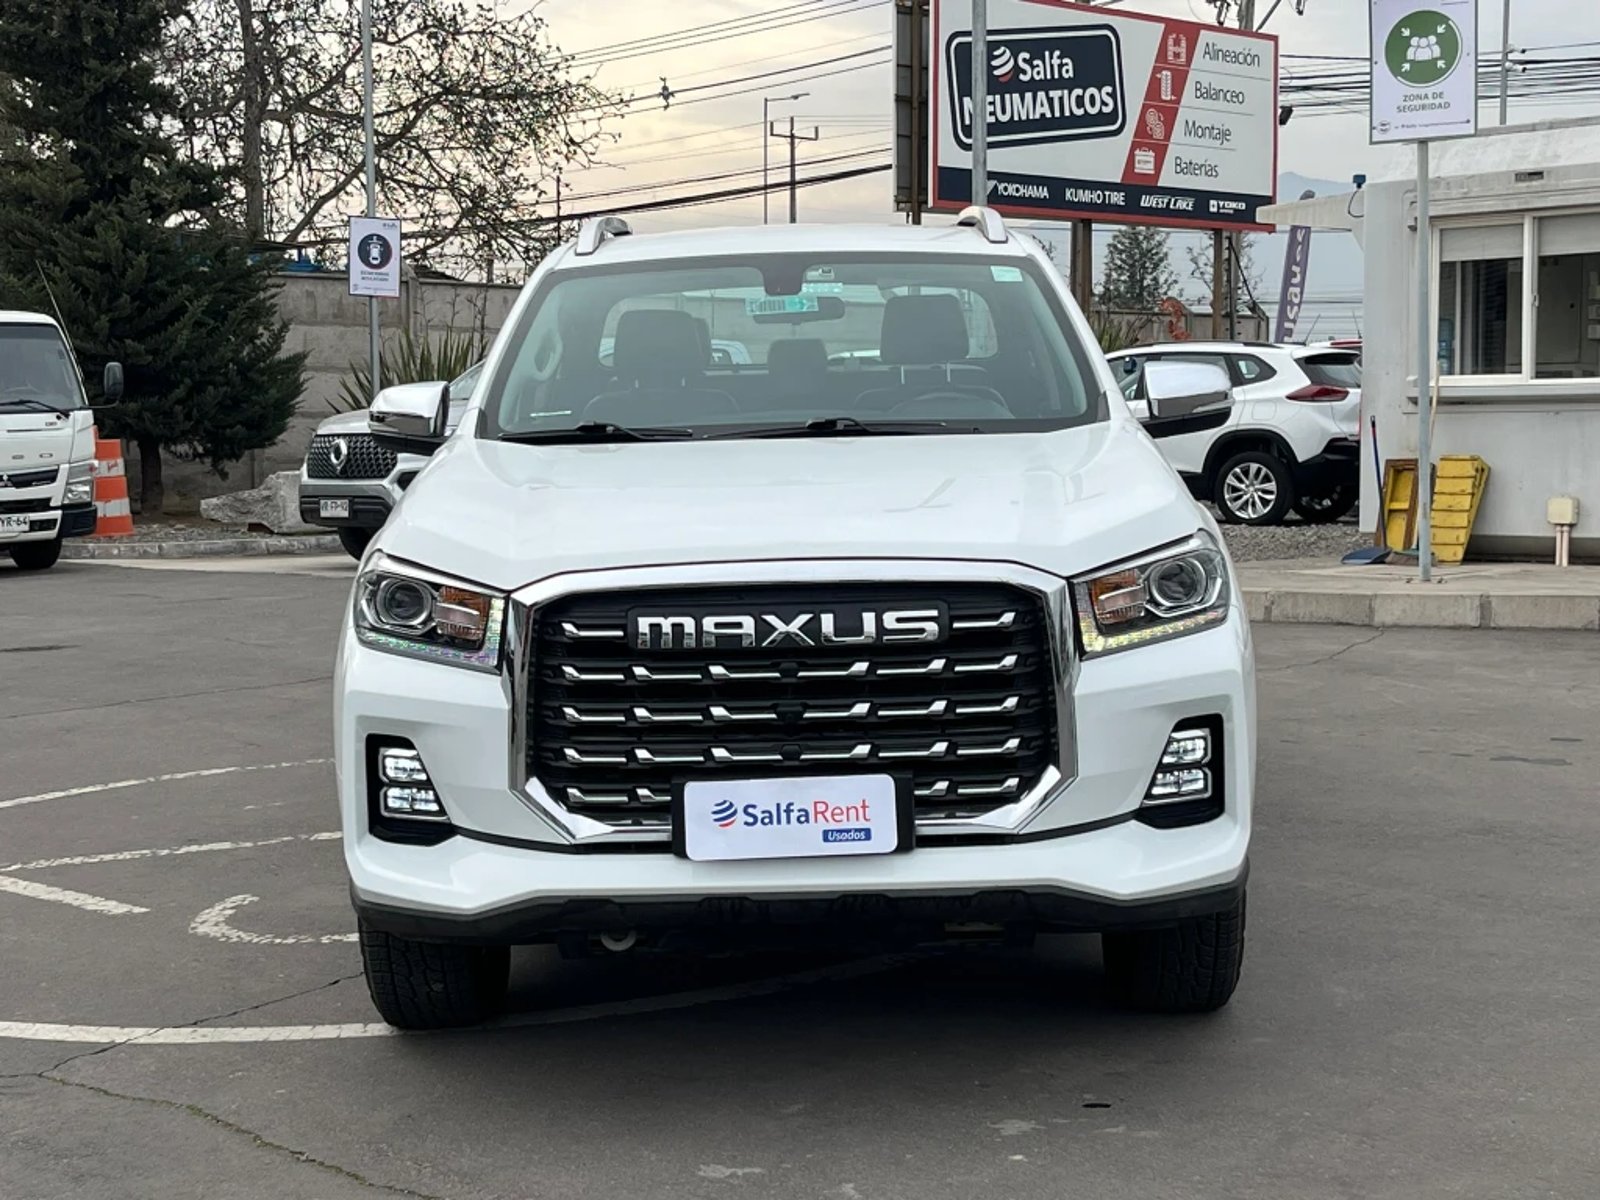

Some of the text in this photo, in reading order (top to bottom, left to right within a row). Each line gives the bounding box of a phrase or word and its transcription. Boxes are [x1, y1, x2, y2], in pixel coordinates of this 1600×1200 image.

[1017, 50, 1074, 82] Salfa
[1202, 41, 1260, 67] Alineación
[1194, 80, 1245, 105] Balanceo
[1402, 91, 1445, 103] ZONA DE
[962, 85, 1115, 126] NEUMATICOS
[1396, 101, 1451, 114] SEGURIDAD
[1183, 119, 1232, 146] Montaje
[1174, 156, 1219, 179] Baterías
[996, 182, 1050, 199] YOKOHAMA
[1064, 187, 1126, 206] KUMHO TIRE
[636, 609, 940, 649] MAXUS
[827, 828, 866, 841] Usados
